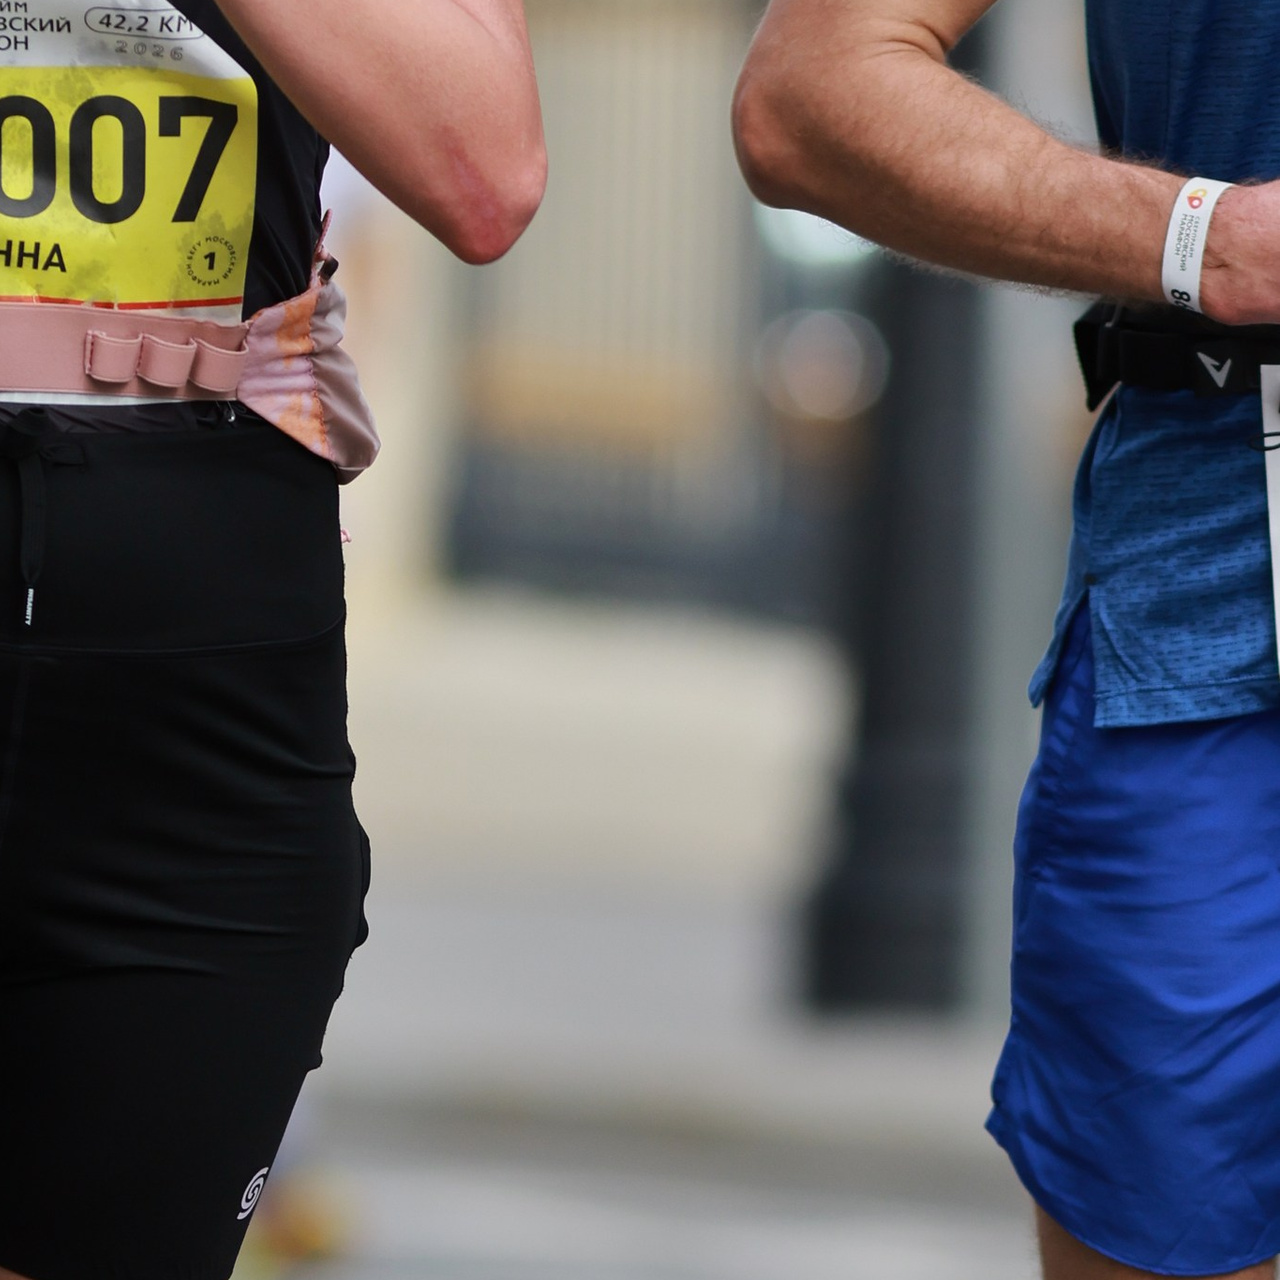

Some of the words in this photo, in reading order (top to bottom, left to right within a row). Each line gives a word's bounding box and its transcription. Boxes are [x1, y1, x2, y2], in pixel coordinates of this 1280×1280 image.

[98, 13, 149, 32] 42,2
[115, 40, 184, 61] 2026
[1174, 213, 1188, 256] МАРАФОН
[1179, 214, 1194, 271] МОСКОВСКИЙ
[204, 252, 215, 270] 1
[186, 264, 219, 286] МАРАФОН
